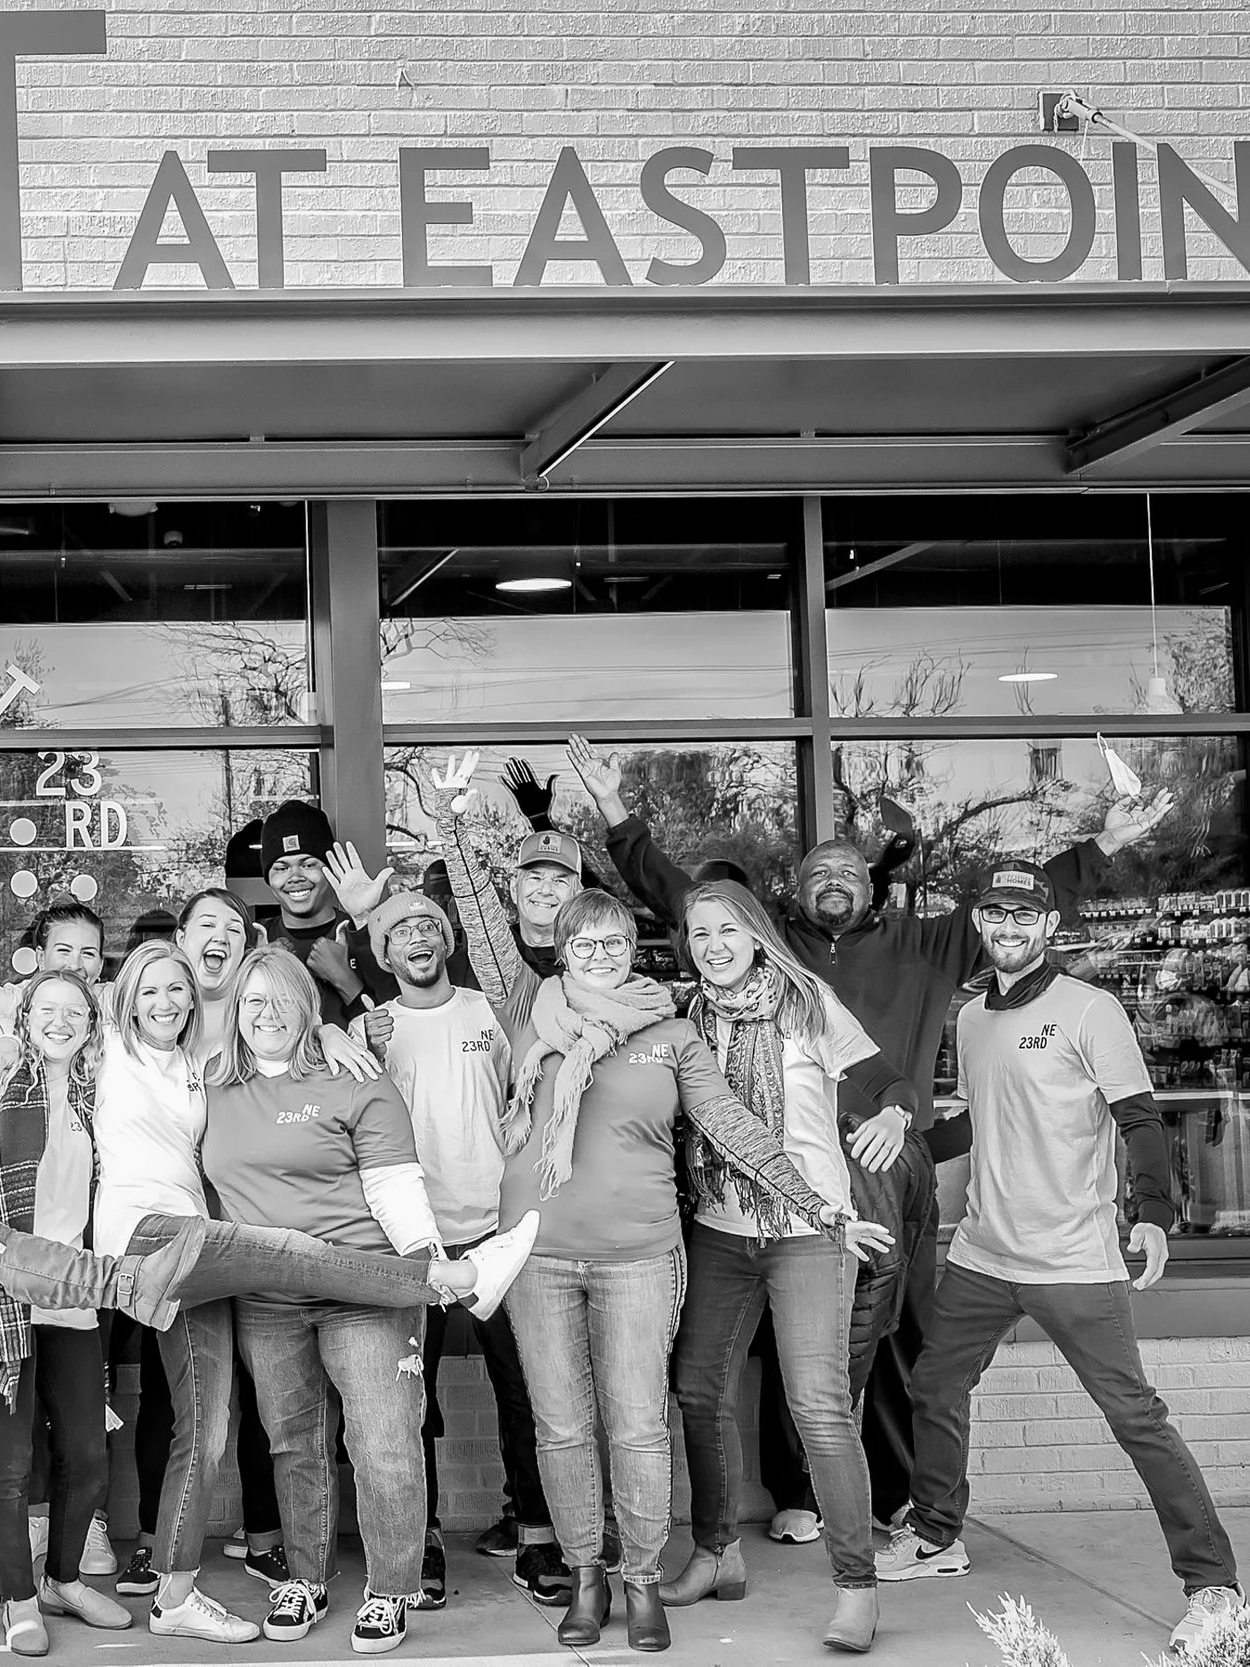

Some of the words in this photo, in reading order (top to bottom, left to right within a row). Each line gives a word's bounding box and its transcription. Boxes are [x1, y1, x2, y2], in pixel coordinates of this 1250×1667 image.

[112, 148, 327, 290] AT
[36, 752, 101, 796] 23
[65, 801, 127, 849] RD
[480, 1029, 494, 1041] NE
[1041, 1024, 1057, 1037] NE
[461, 1040, 491, 1053] 23RD
[1018, 1036, 1047, 1049] 23RD
[652, 1043, 669, 1057] NE
[302, 1103, 321, 1118] NE
[276, 1111, 310, 1125] 23RD
